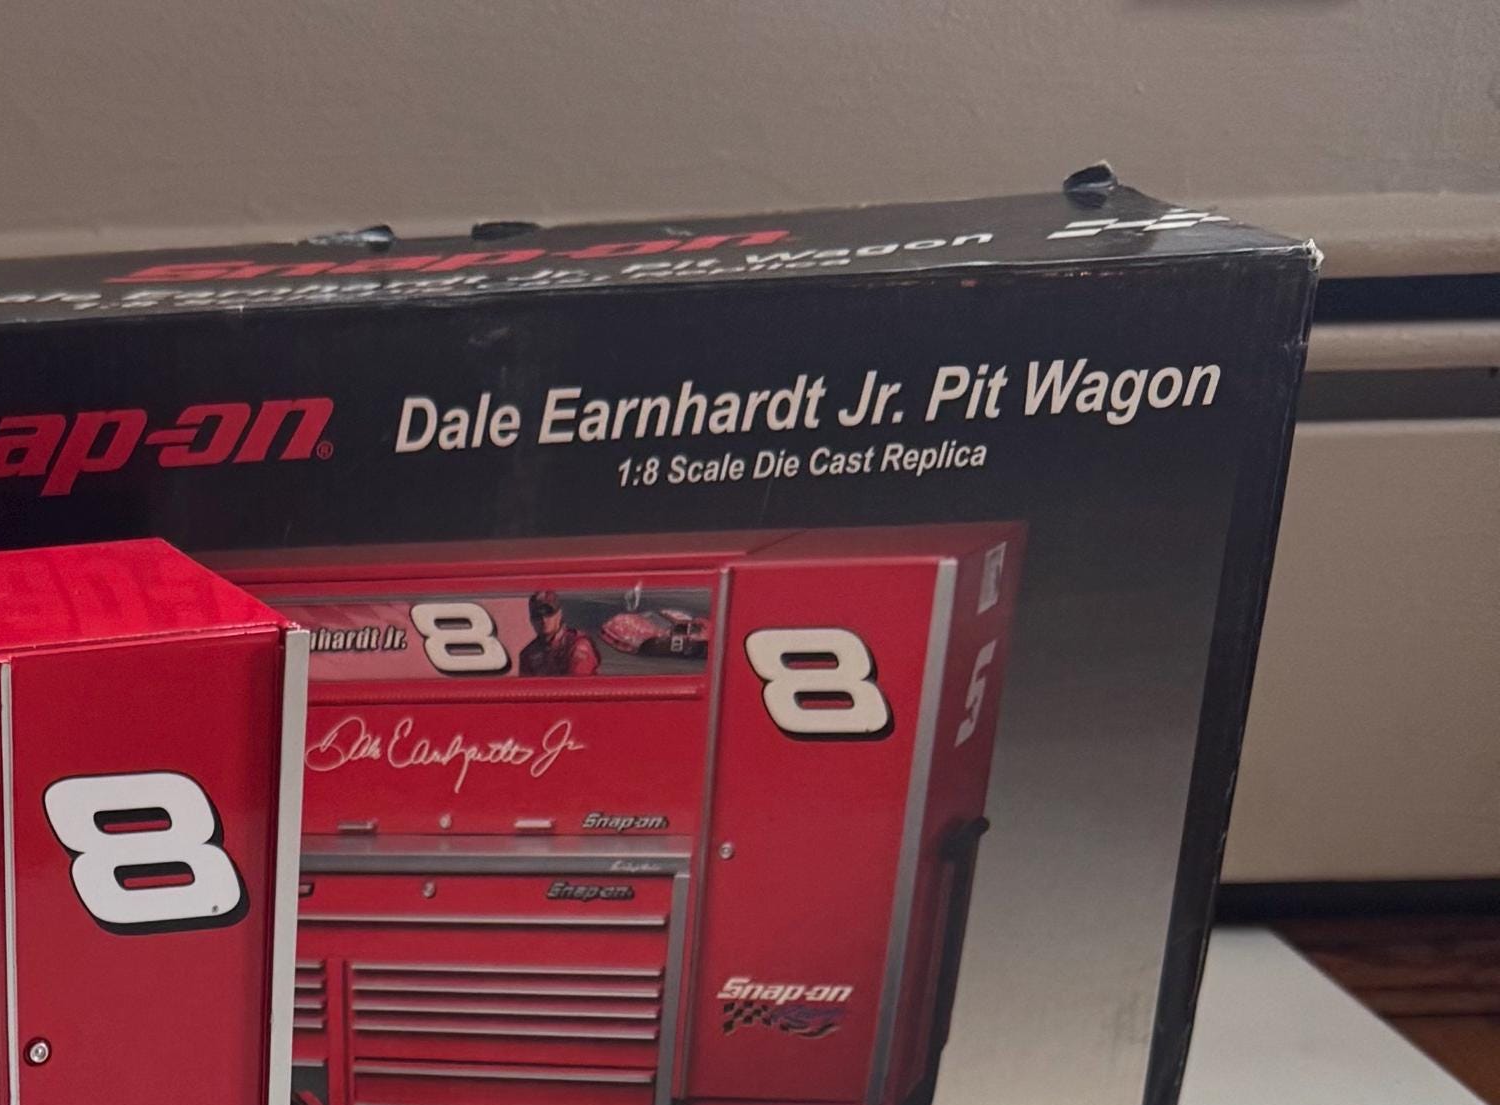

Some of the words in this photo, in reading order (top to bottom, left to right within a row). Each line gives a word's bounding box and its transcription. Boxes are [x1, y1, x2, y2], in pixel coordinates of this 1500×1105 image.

[104, 229, 790, 284] Snap-on
[745, 232, 994, 263] Wagon
[394, 392, 522, 454] Dale
[537, 373, 827, 445] Earnhardt
[837, 369, 905, 428] Jr.
[924, 363, 1009, 423] Pit
[1023, 357, 1222, 426] Wagon
[617, 456, 661, 488] 1:8
[667, 452, 745, 485] Scale
[752, 447, 801, 480] Die
[808, 445, 876, 477] Cast
[880, 440, 988, 478] Replica
[383, 625, 408, 651] Jr.
[410, 602, 512, 677] 8
[743, 627, 895, 742] 8
[582, 811, 668, 832] Snap-on
[41, 769, 250, 936] 8
[716, 976, 854, 1007] Snap-on
